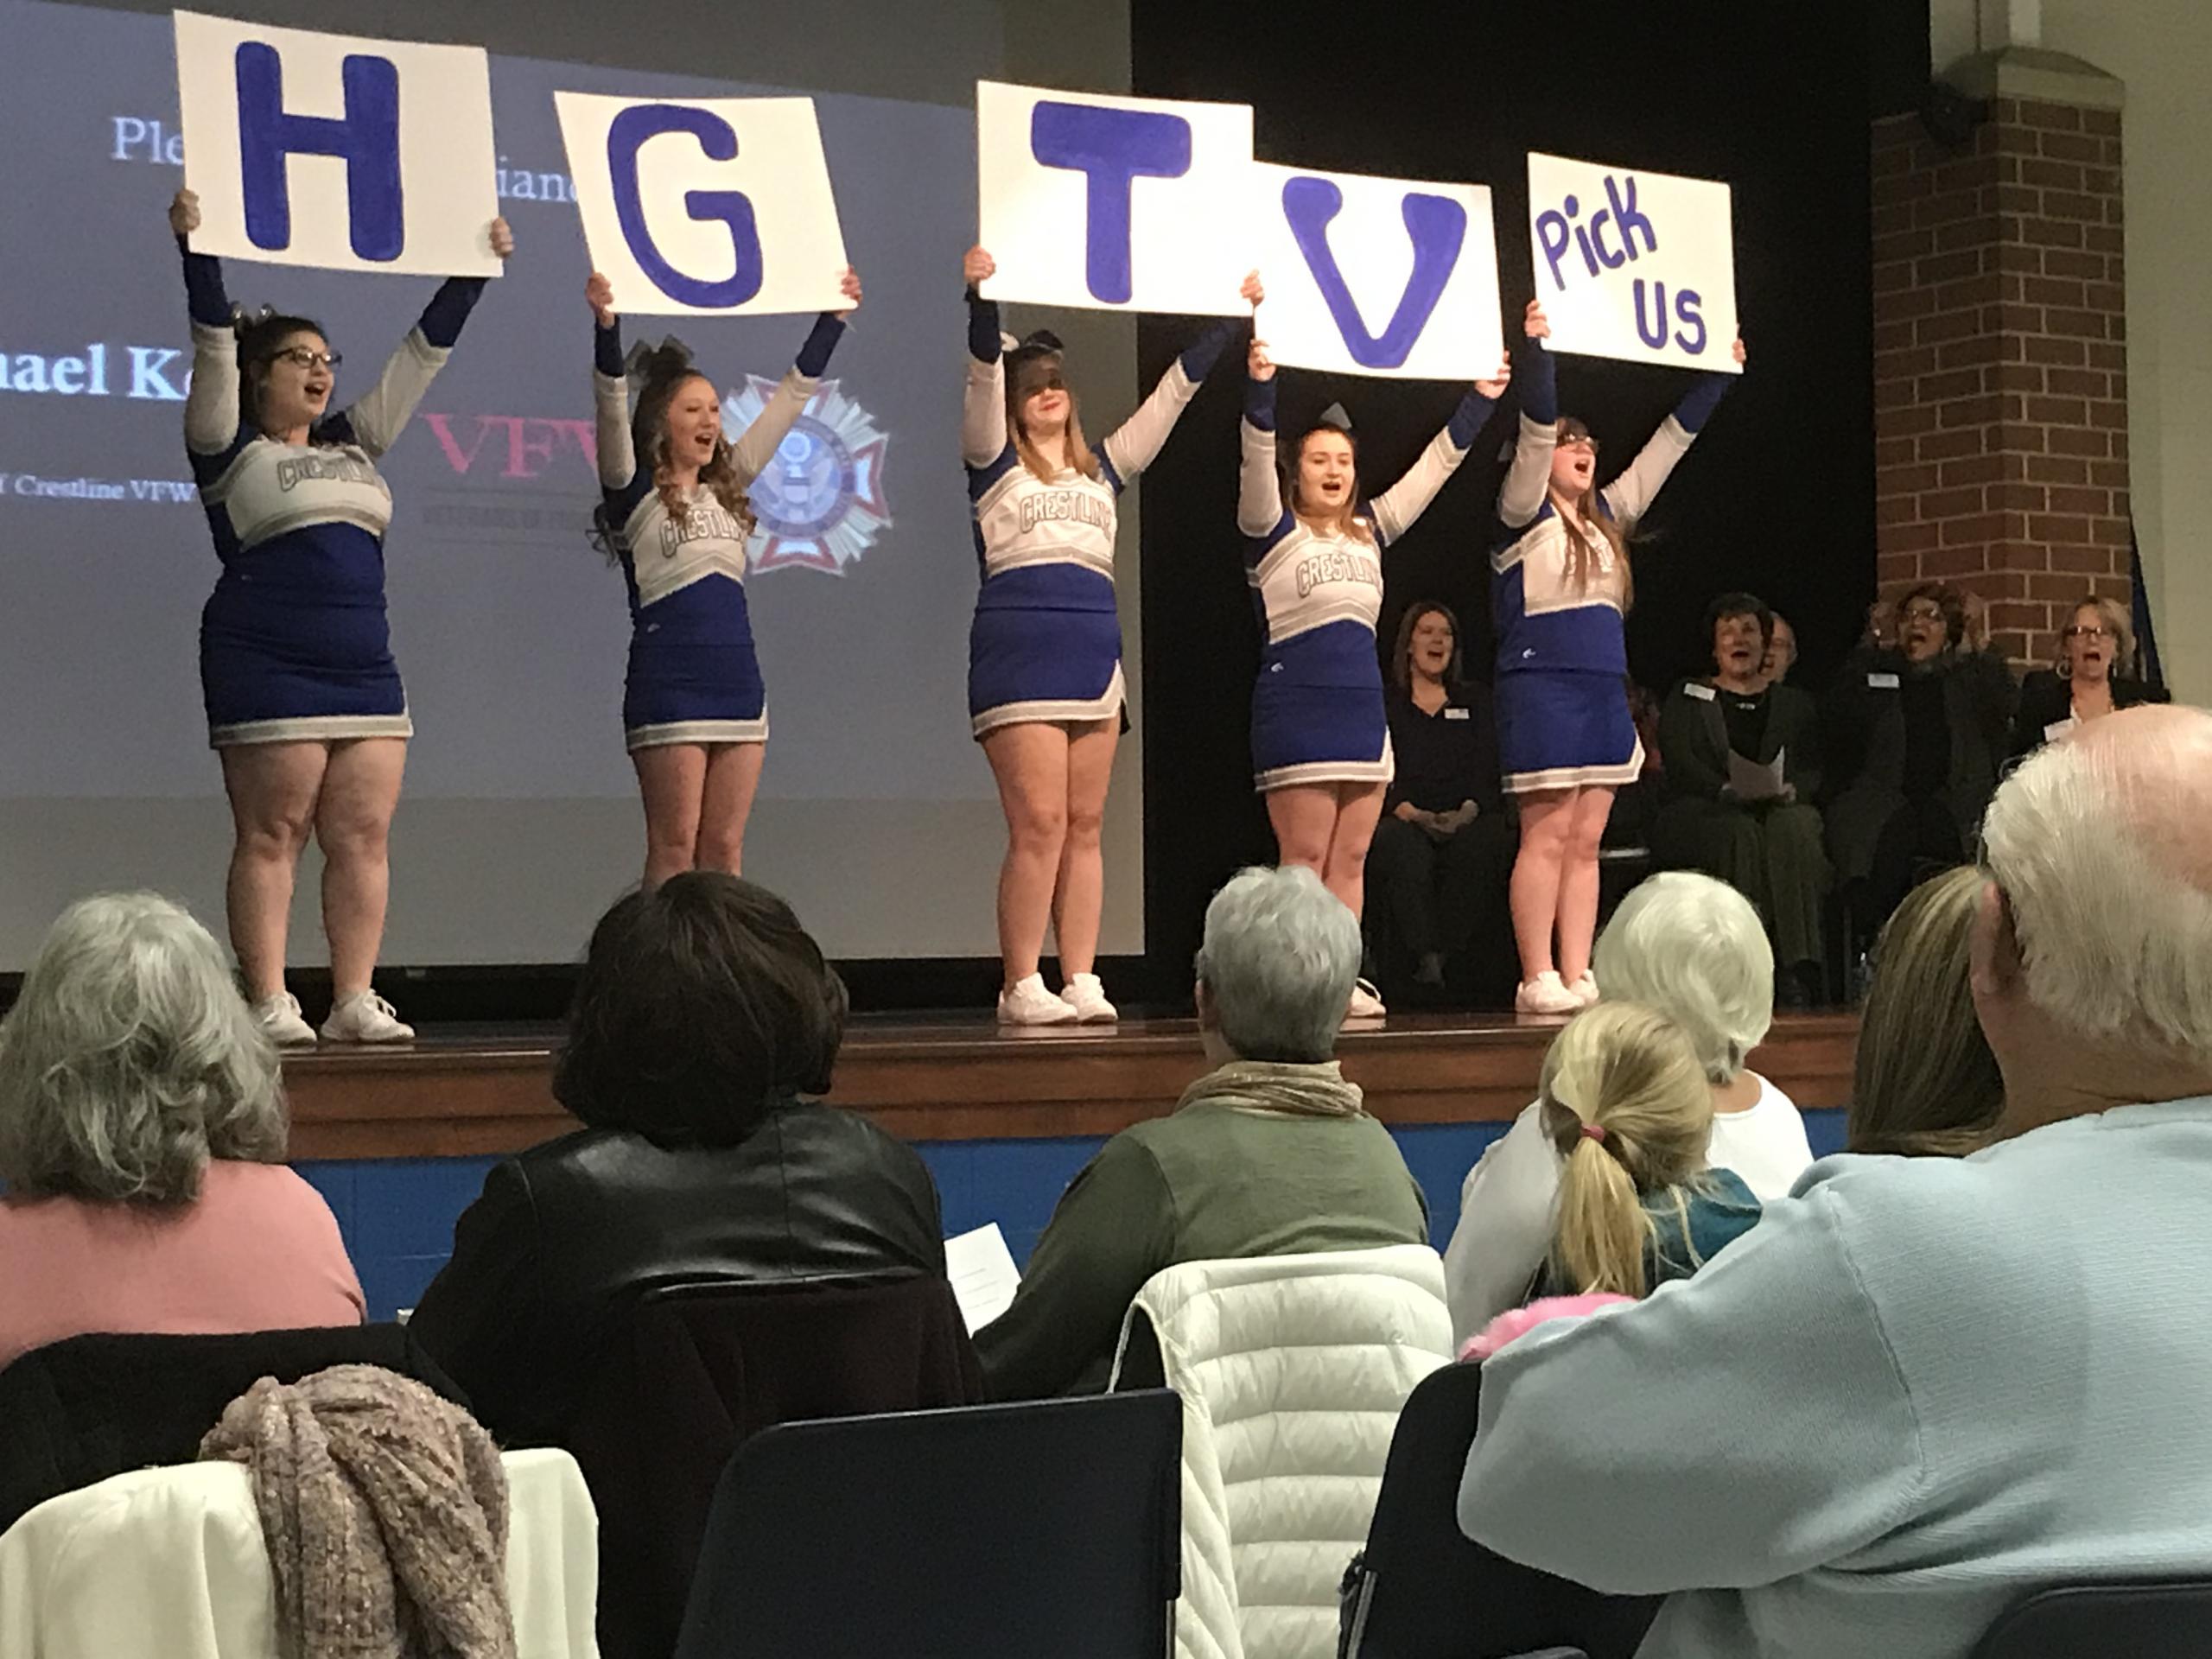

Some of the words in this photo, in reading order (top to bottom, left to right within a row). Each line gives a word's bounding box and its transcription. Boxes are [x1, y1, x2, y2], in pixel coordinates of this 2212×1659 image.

[235, 41, 404, 262] H
[607, 104, 763, 308] G
[1031, 100, 1192, 304] T
[1281, 176, 1467, 369] V
[126, 346, 194, 401] K
[14, 475, 125, 499] Crestline
[130, 480, 198, 502] VFW
